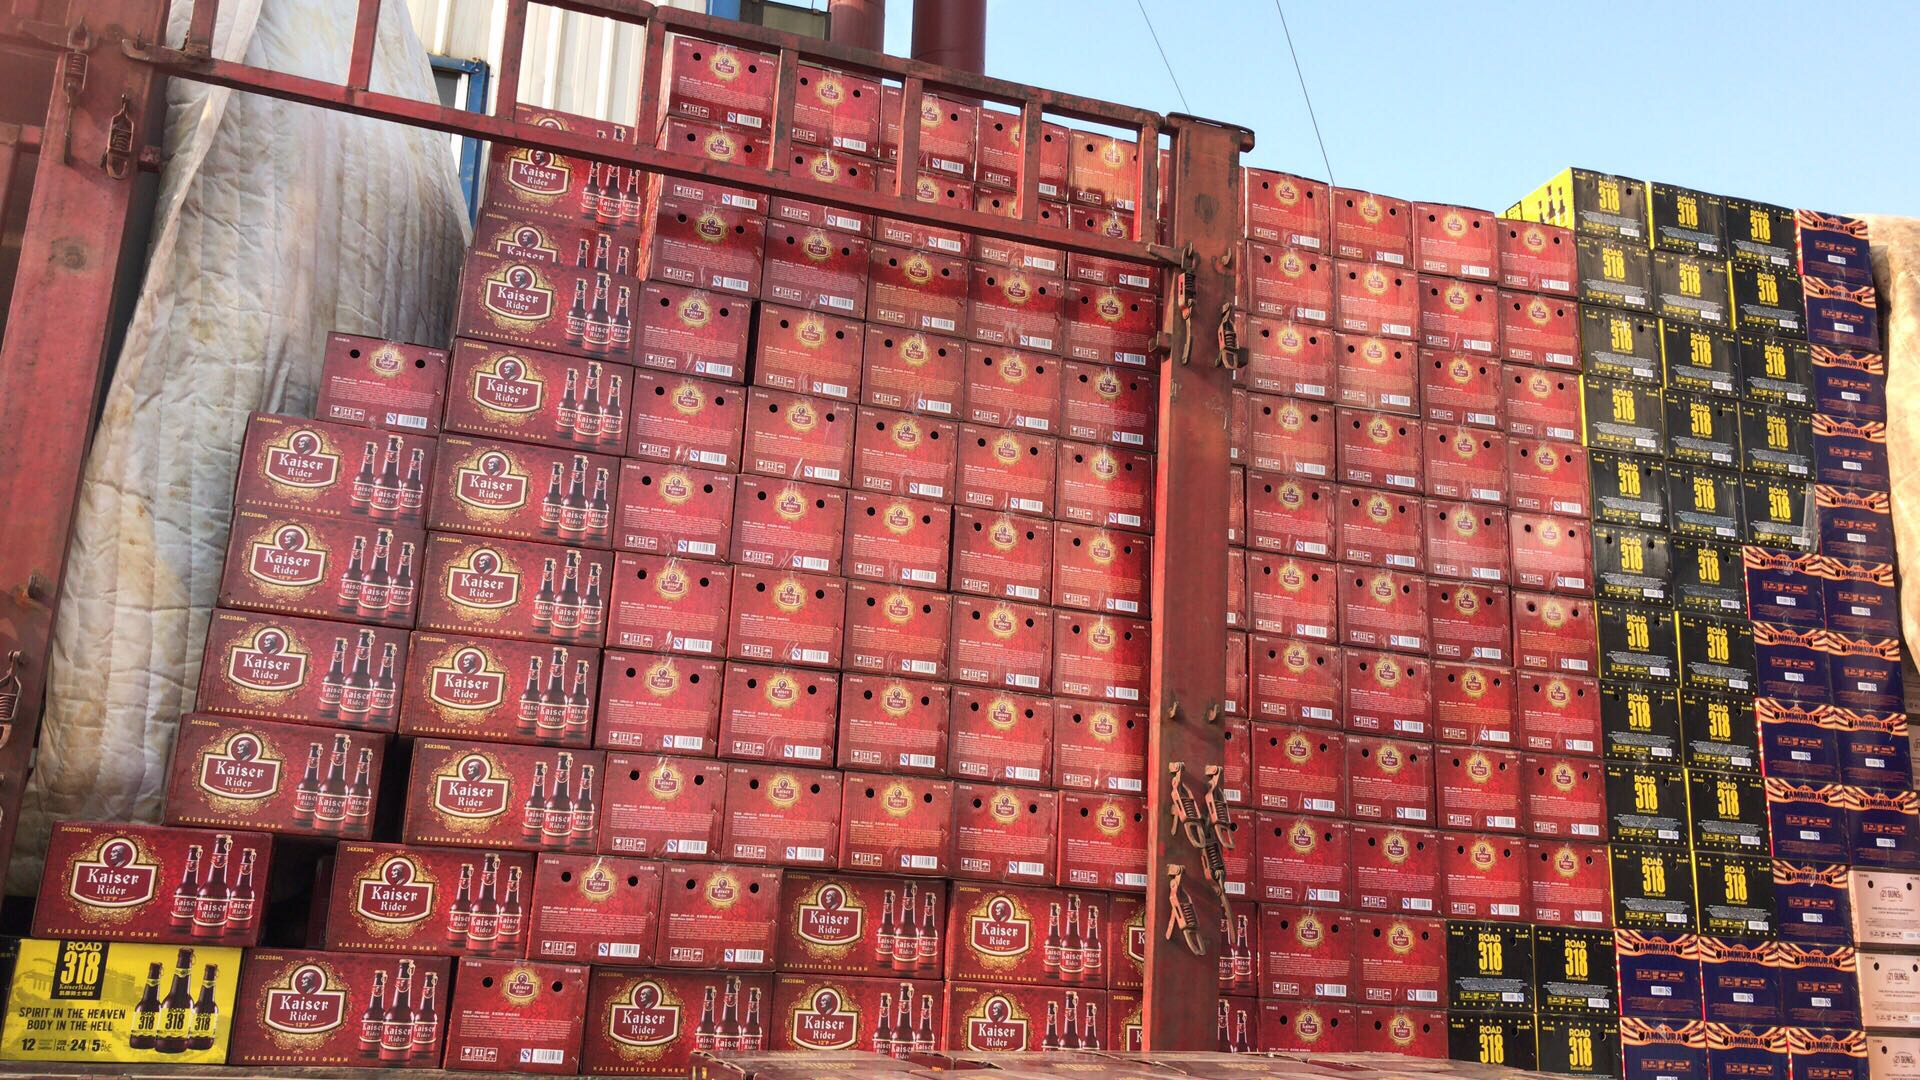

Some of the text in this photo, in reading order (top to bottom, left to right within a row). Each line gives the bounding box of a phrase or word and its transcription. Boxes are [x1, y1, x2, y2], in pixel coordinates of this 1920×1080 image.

[520, 164, 556, 181] Kaiser
[527, 177, 548, 186] Rider
[1598, 181, 1617, 189] ROAD
[1599, 187, 1620, 211] 318
[1677, 196, 1696, 204] ROAD
[1678, 203, 1698, 226] 318
[1751, 210, 1769, 218] ROAD
[1751, 217, 1770, 240] 318
[1603, 248, 1623, 256] ROAD
[1603, 255, 1625, 278] 318
[1680, 263, 1699, 272] ROAD
[1680, 270, 1700, 293] 318
[1757, 273, 1775, 281] ROAD
[497, 287, 538, 304] Kaiser
[1758, 280, 1778, 302] 318
[506, 301, 529, 311] Rider
[1611, 319, 1630, 327] ROAD
[1611, 326, 1632, 350] 318
[1691, 333, 1710, 341] ROAD
[1691, 340, 1712, 364] 318
[1765, 345, 1783, 353] ROAD
[1765, 352, 1786, 376] 318
[487, 379, 528, 395] Kaiser
[1613, 388, 1633, 397] ROAD
[495, 392, 518, 403] Rider
[1613, 396, 1635, 420] 318
[1691, 403, 1709, 412] ROAD
[1691, 411, 1712, 434] 318
[1767, 416, 1786, 424] ROAD
[1767, 423, 1788, 447] 318
[279, 453, 323, 470] Kaiser
[1618, 462, 1638, 470] ROAD
[288, 467, 312, 478] Rider
[470, 476, 512, 491] Kaiser
[1618, 469, 1640, 494] 318
[1694, 477, 1713, 485] ROAD
[478, 489, 502, 499] Rider
[1694, 484, 1715, 509] 318
[1769, 487, 1788, 495] ROAD
[1769, 494, 1791, 518] 318
[1621, 537, 1640, 545] ROAD
[264, 550, 310, 567] Kaiser
[1621, 545, 1643, 569] 318
[273, 565, 299, 576] Rider
[1698, 555, 1719, 580] 318
[461, 575, 504, 589] Kaiser
[469, 588, 494, 598] Rider
[1627, 614, 1646, 622] ROAD
[1627, 622, 1649, 647] 318
[1707, 627, 1727, 635] ROAD
[1707, 635, 1729, 660] 318
[243, 654, 290, 670] Kaiser
[252, 669, 278, 680] Rider
[445, 674, 488, 689] Kaiser
[453, 689, 478, 698] Rider
[1628, 701, 1651, 727] 318
[1708, 704, 1728, 712] ROAD
[1709, 711, 1730, 737] 318
[216, 761, 264, 778] Kaiser
[225, 777, 252, 787] Rider
[449, 782, 493, 797] Kaiser
[1635, 783, 1657, 809] 318
[457, 797, 483, 807] Rider
[1717, 789, 1739, 815] 318
[86, 869, 140, 885] Kaiser
[1642, 865, 1665, 892] 318
[97, 884, 126, 895] Rider
[1725, 873, 1747, 900] 318
[371, 886, 417, 901] Kaiser
[381, 902, 407, 911] Rider
[810, 911, 849, 925] Kaiser
[818, 925, 840, 934] Rider
[981, 923, 1017, 936] Kaiser
[989, 936, 1010, 945] Rider
[1479, 934, 1500, 942] ROAD
[1565, 940, 1586, 948] ROAD
[67, 942, 102, 951] ROAD
[1479, 942, 1502, 970] 318
[1565, 948, 1588, 976] 318
[61, 951, 101, 984] 318
[280, 995, 328, 1011] Kaiser
[19, 1007, 126, 1019] SPIRIT IN THE HEAVEN
[290, 1012, 317, 1021] Rider
[622, 1010, 665, 1024] Kaiser
[27, 1020, 113, 1031] BODY IN THE HELL
[139, 1016, 155, 1029] 318
[166, 1013, 184, 1029] 318
[195, 1017, 210, 1030] 318
[805, 1016, 844, 1030] Kaiser
[631, 1025, 655, 1034] Rider
[813, 1030, 835, 1039] Rider
[978, 1024, 1015, 1037] Kaiser
[1480, 1026, 1502, 1034] ROAD
[1569, 1029, 1590, 1037] ROAD
[22, 1039, 35, 1050] 12
[70, 1039, 86, 1050] 24
[92, 1040, 100, 1051] 5
[987, 1037, 1007, 1046] Rider
[1480, 1034, 1504, 1063] 318
[1569, 1037, 1592, 1066] 318
